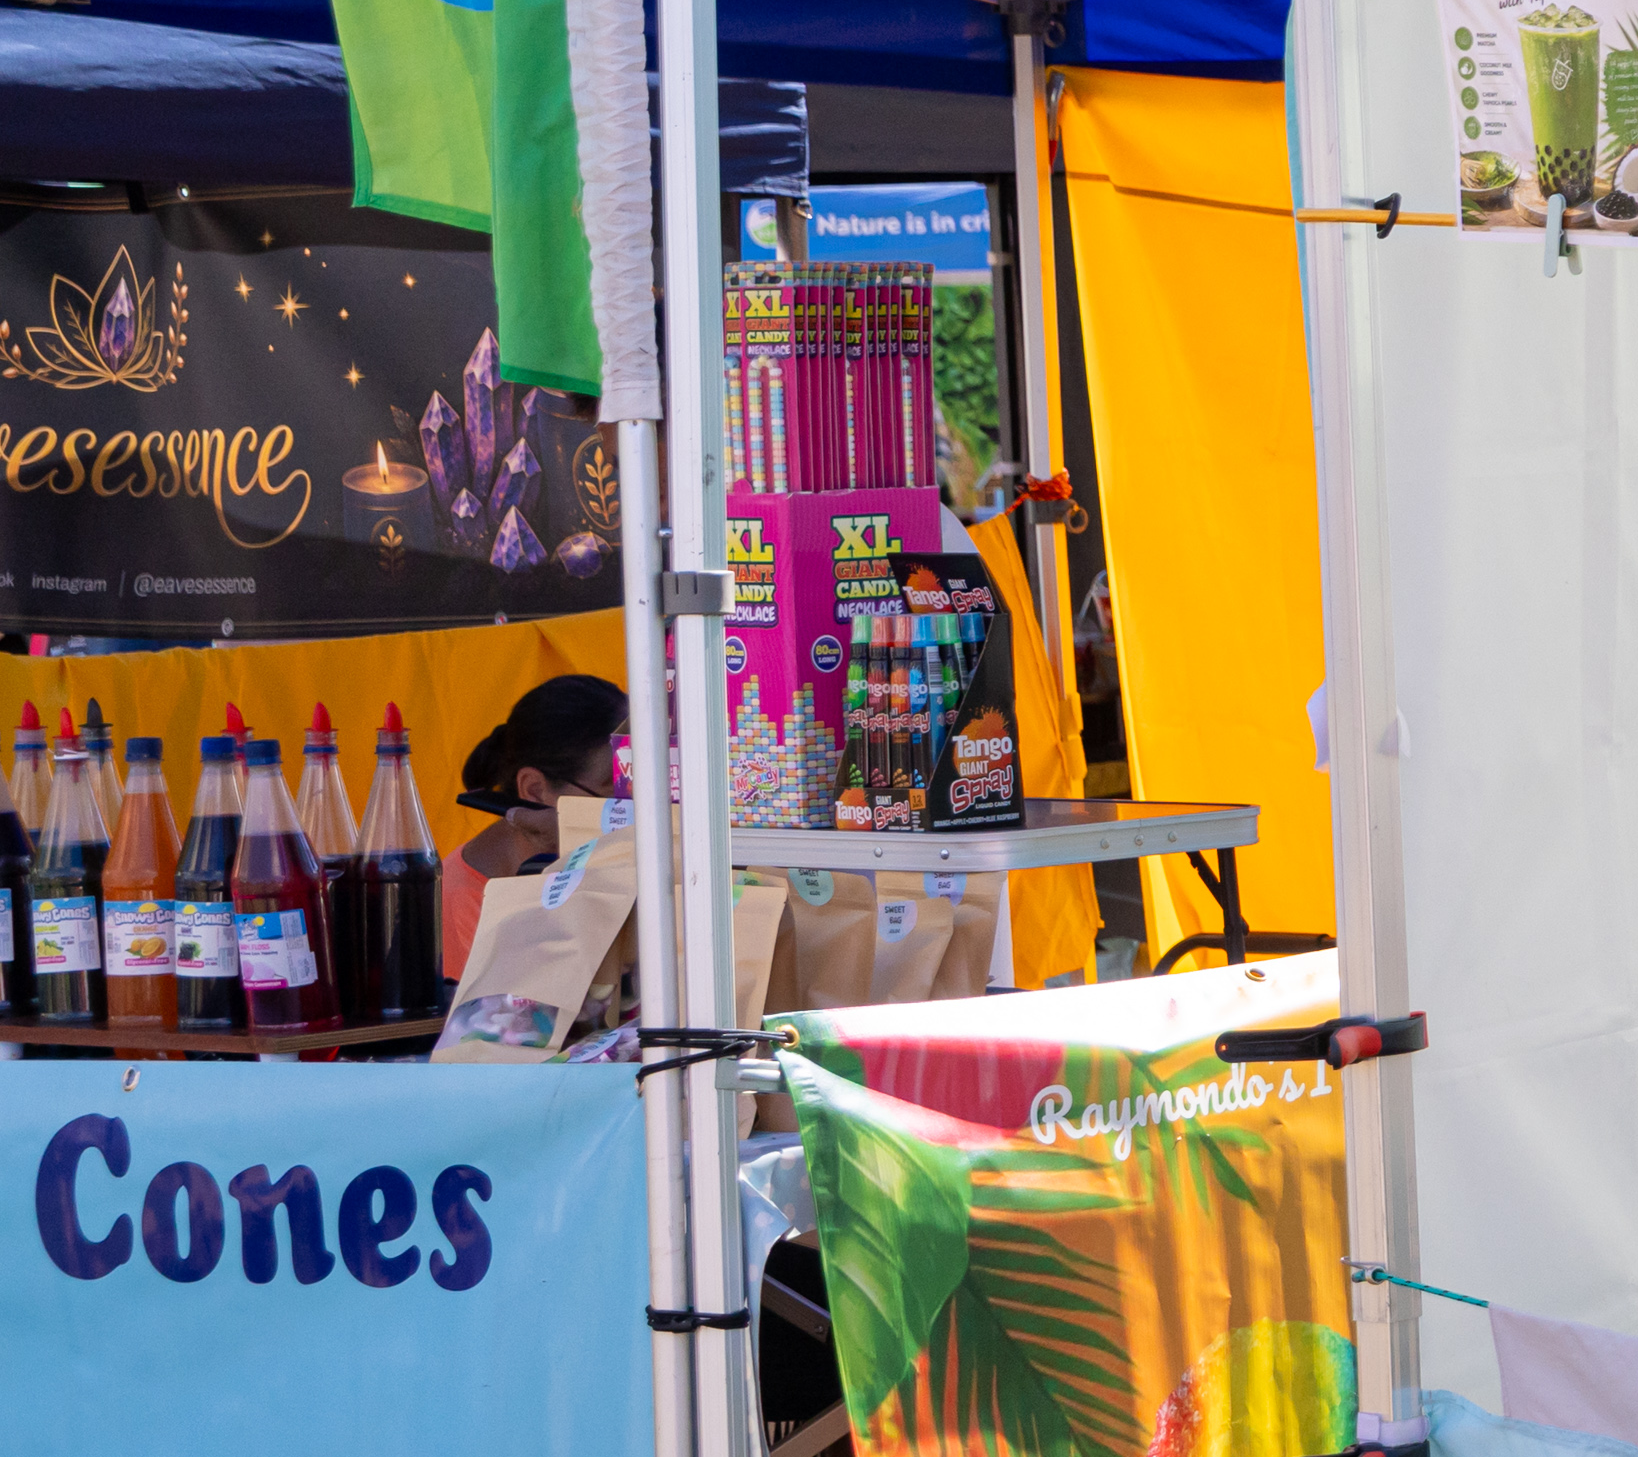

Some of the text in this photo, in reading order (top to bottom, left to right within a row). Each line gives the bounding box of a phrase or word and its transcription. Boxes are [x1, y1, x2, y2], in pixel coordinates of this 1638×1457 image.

[816, 213, 901, 236] Nature
[906, 210, 926, 235] is
[931, 211, 956, 233] in
[744, 289, 790, 317] XL
[746, 318, 791, 330] GIANT
[746, 332, 791, 343] CANDY
[748, 344, 791, 355] NECKLACE
[32, 571, 256, 597] instagram @eavesessence
[953, 736, 1012, 760] Tango
[960, 762, 990, 777] GIANT
[951, 765, 1013, 813] Spray
[1030, 1062, 1306, 1161] Raymondos
[36, 1113, 492, 1291] Cones
